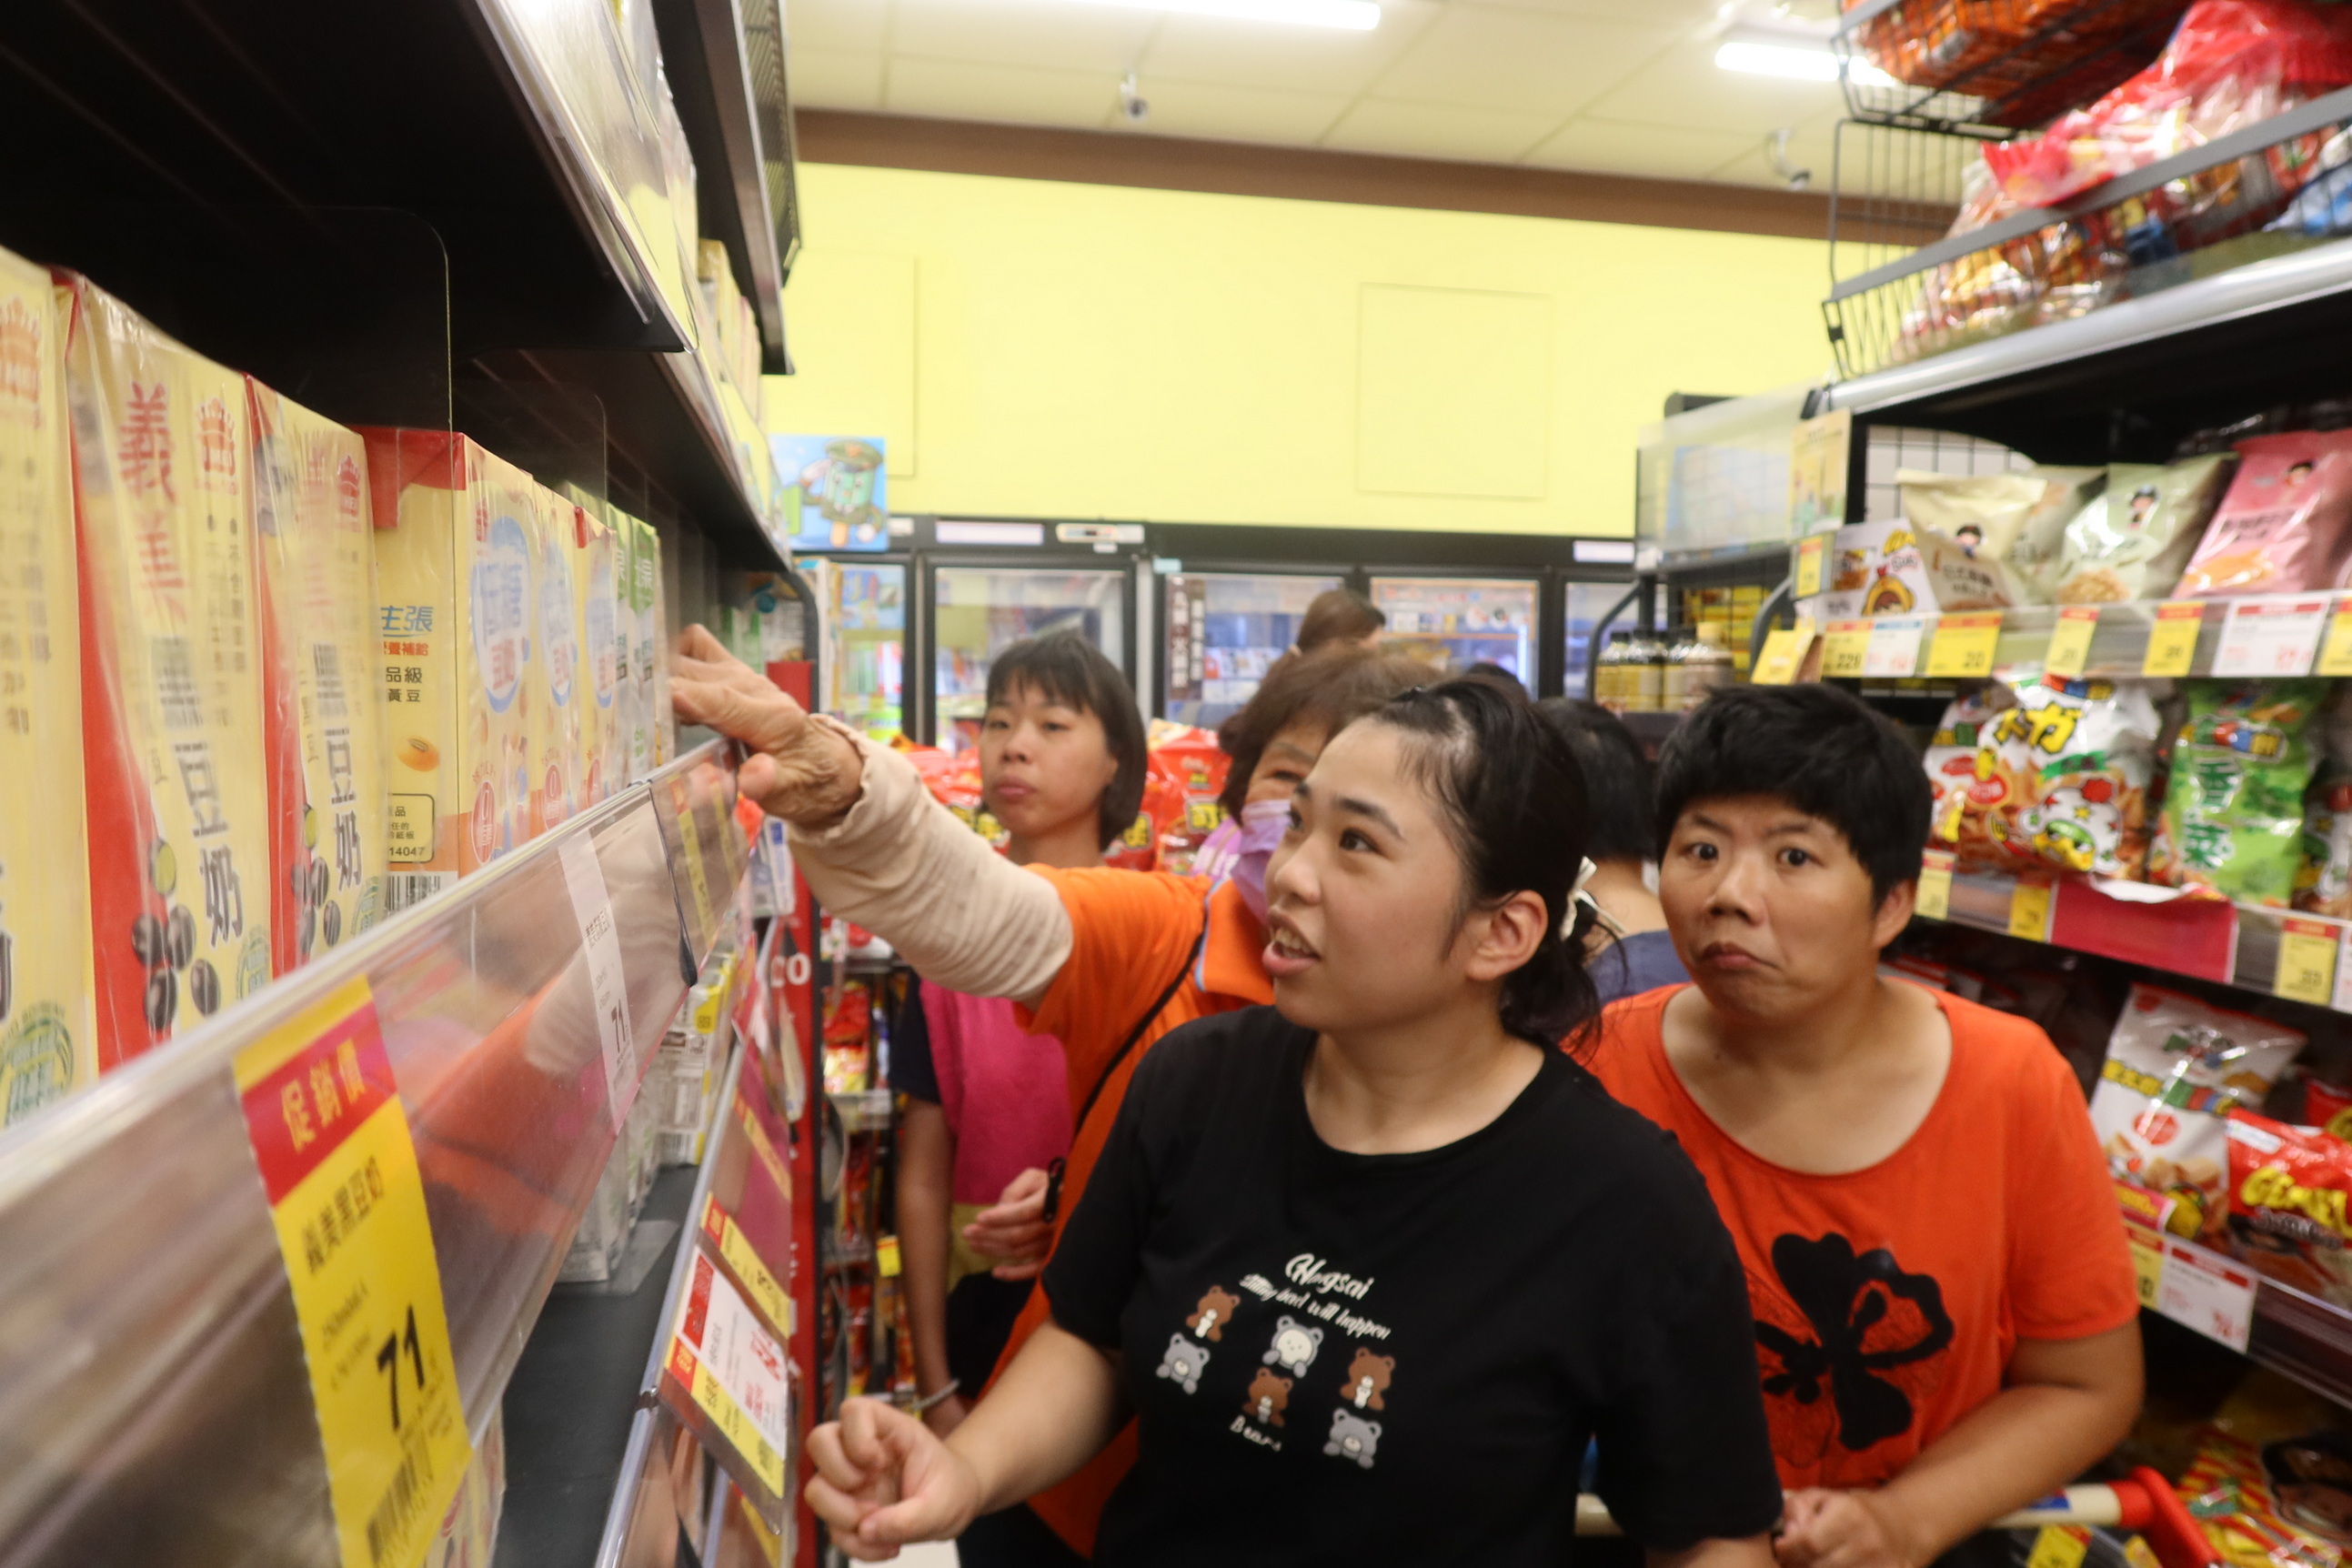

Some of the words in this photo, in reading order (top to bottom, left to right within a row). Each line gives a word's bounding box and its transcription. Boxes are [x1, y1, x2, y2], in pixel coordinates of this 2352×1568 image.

[380, 605, 434, 632] 主張
[383, 641, 429, 656] 養補給
[386, 667, 422, 684] 品級
[387, 689, 421, 703] 黃豆
[281, 1038, 366, 1154] 促銷價
[377, 1303, 425, 1432] 71
